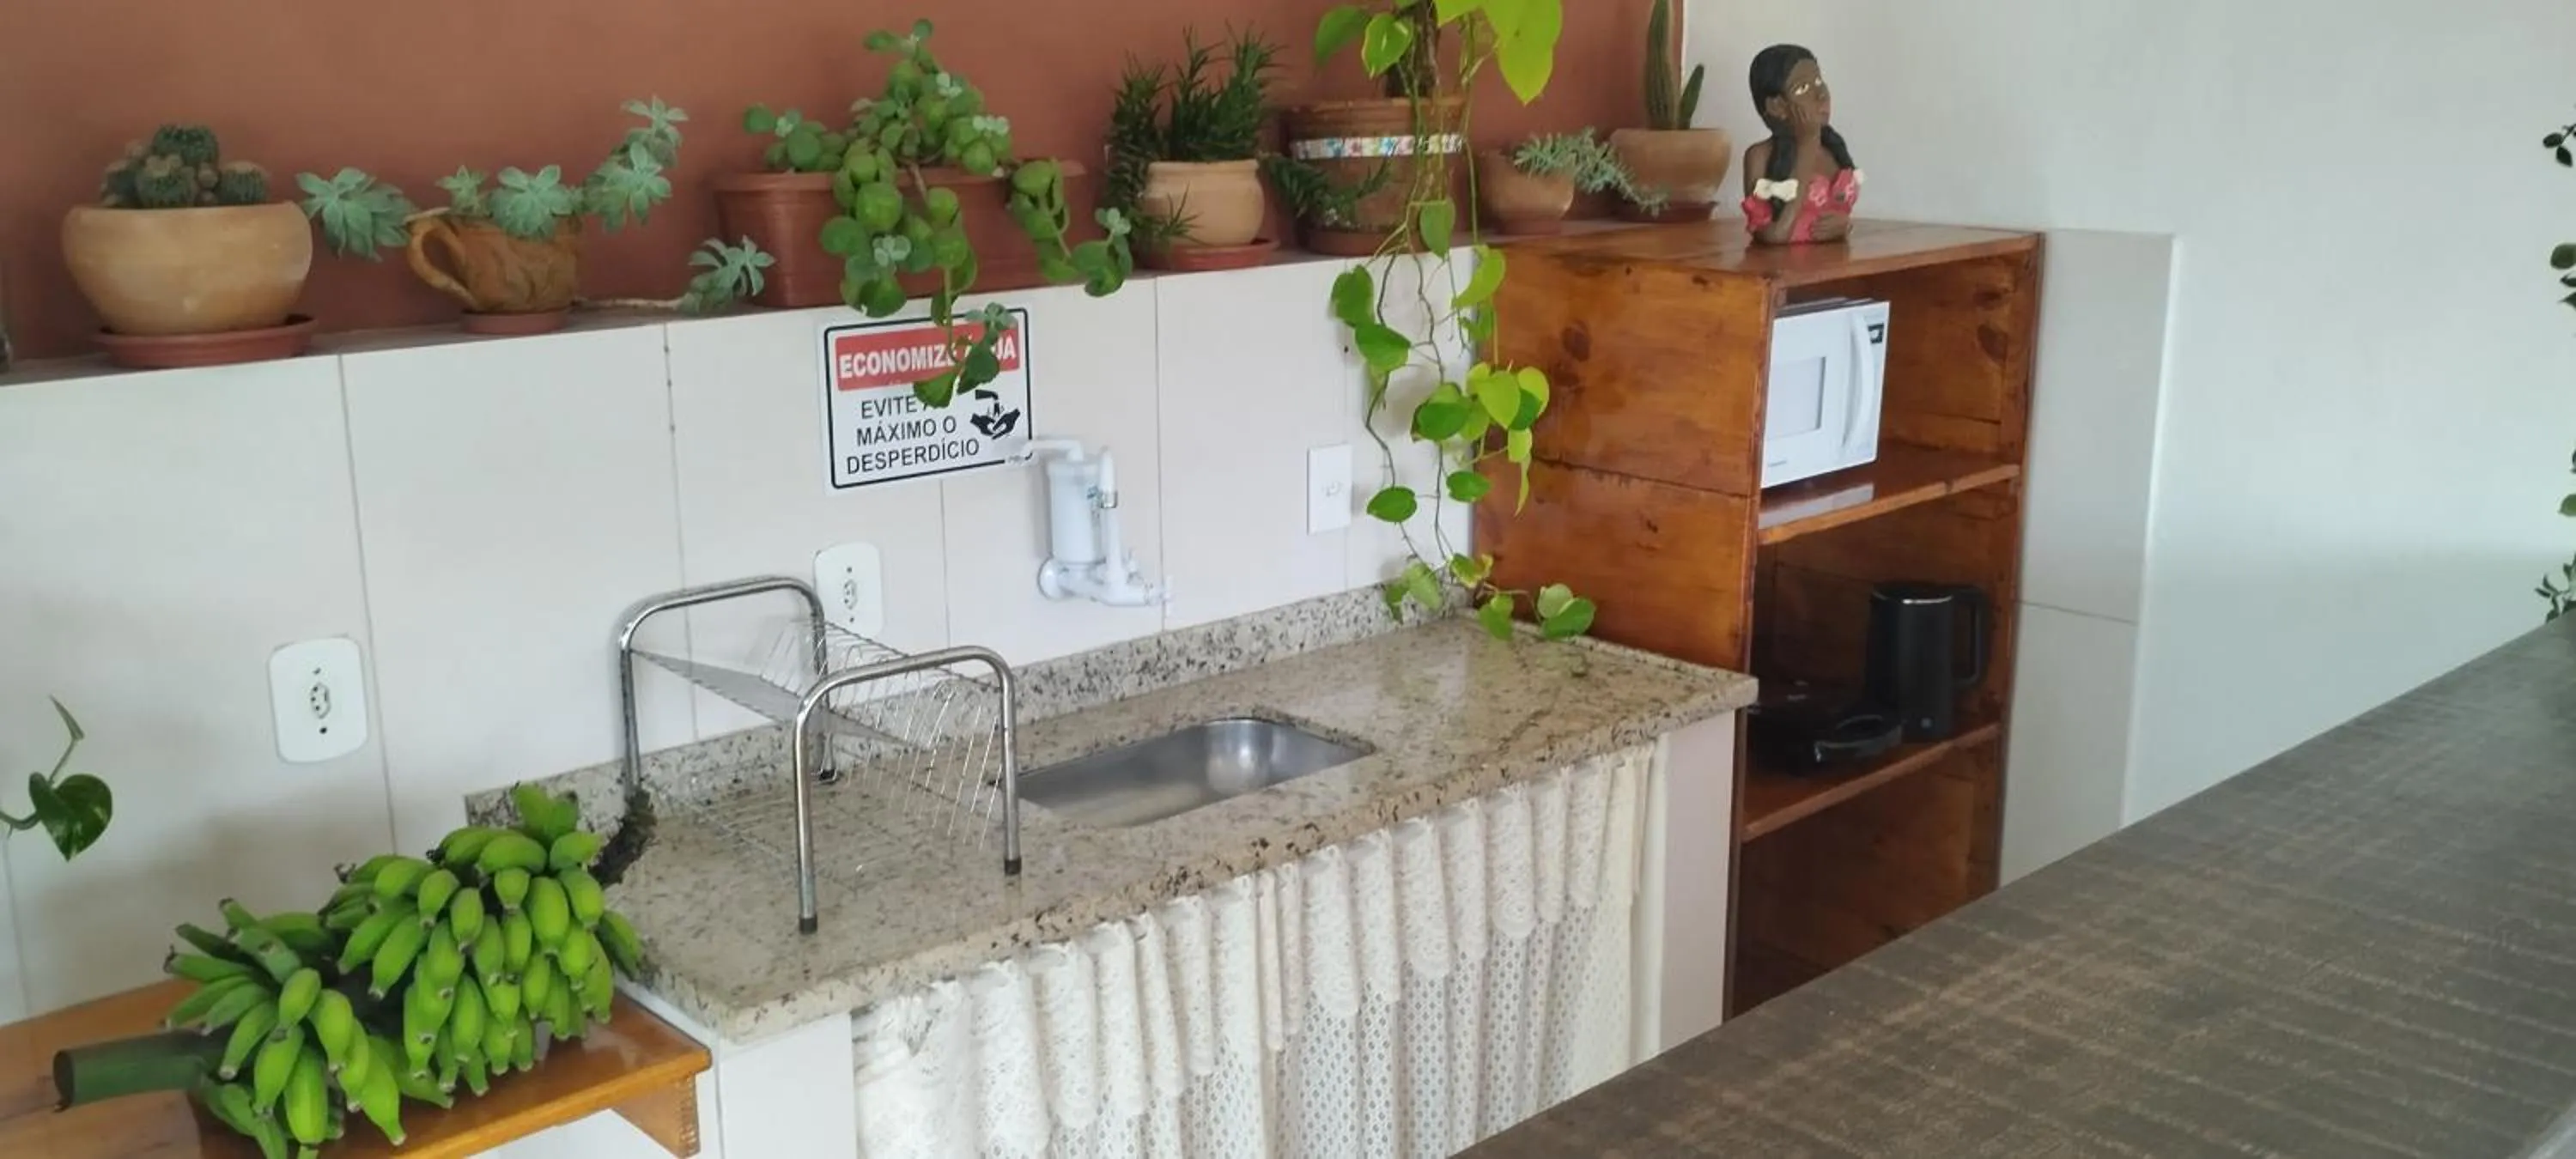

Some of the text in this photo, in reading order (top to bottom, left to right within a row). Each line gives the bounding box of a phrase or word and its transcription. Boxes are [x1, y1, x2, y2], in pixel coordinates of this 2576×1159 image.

[860, 394, 917, 420] EVITE
[856, 416, 957, 446] MÁXIMO O
[847, 437, 980, 475] DESPERDÍCIO
